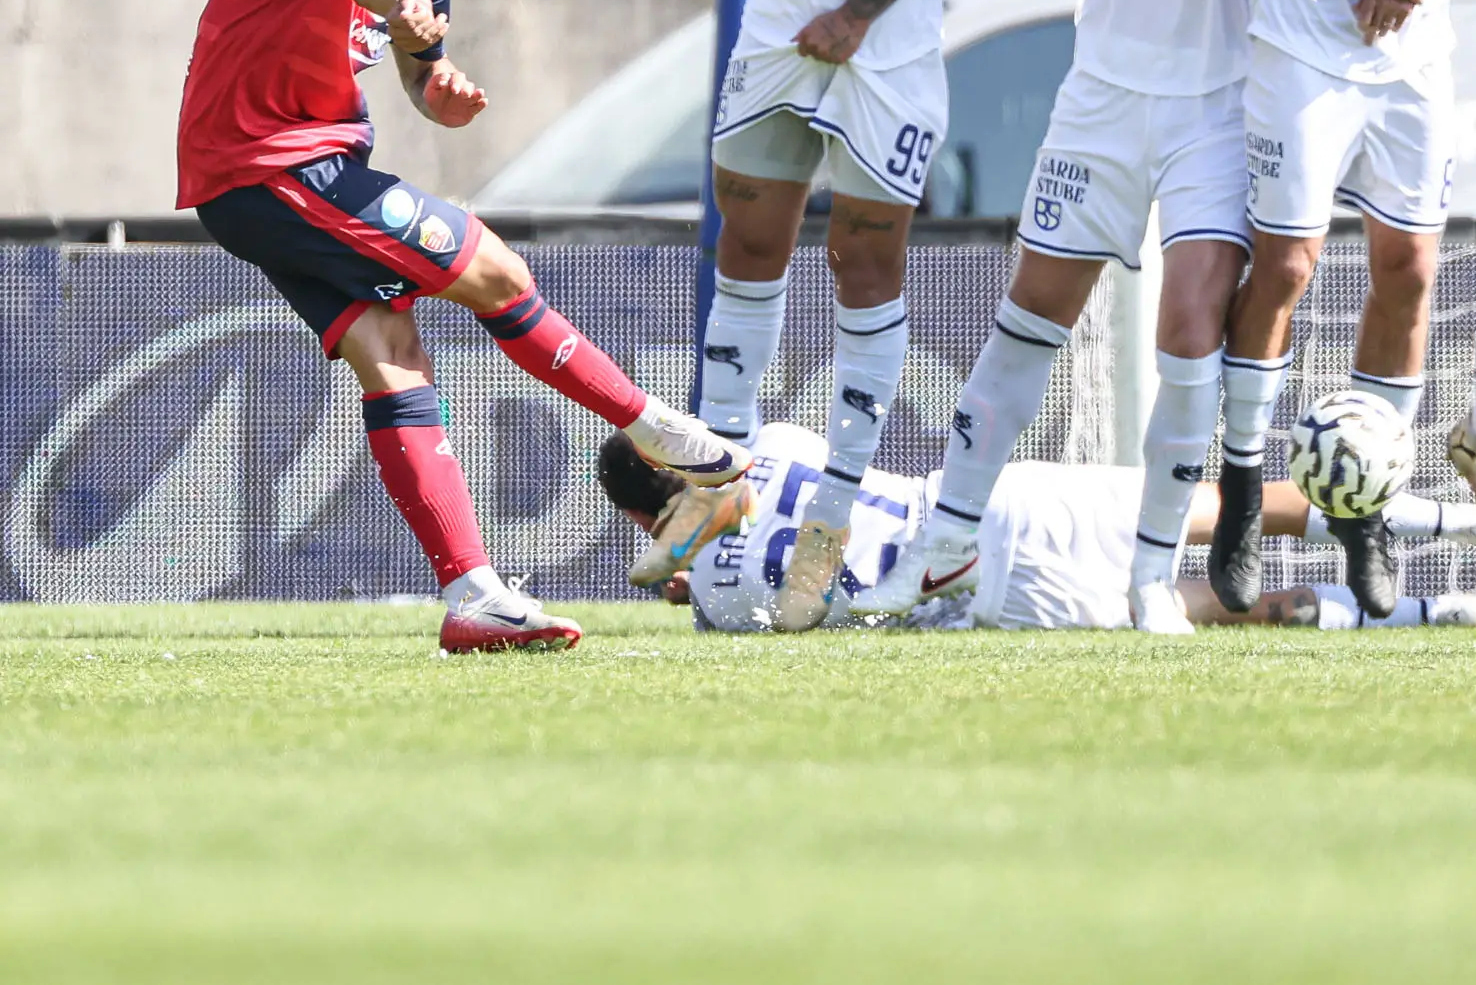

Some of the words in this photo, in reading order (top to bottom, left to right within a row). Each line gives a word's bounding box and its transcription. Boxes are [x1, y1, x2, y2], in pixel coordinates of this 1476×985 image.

[886, 123, 934, 185] 99
[1040, 156, 1090, 184] GARDA
[1036, 176, 1086, 204] STUBE
